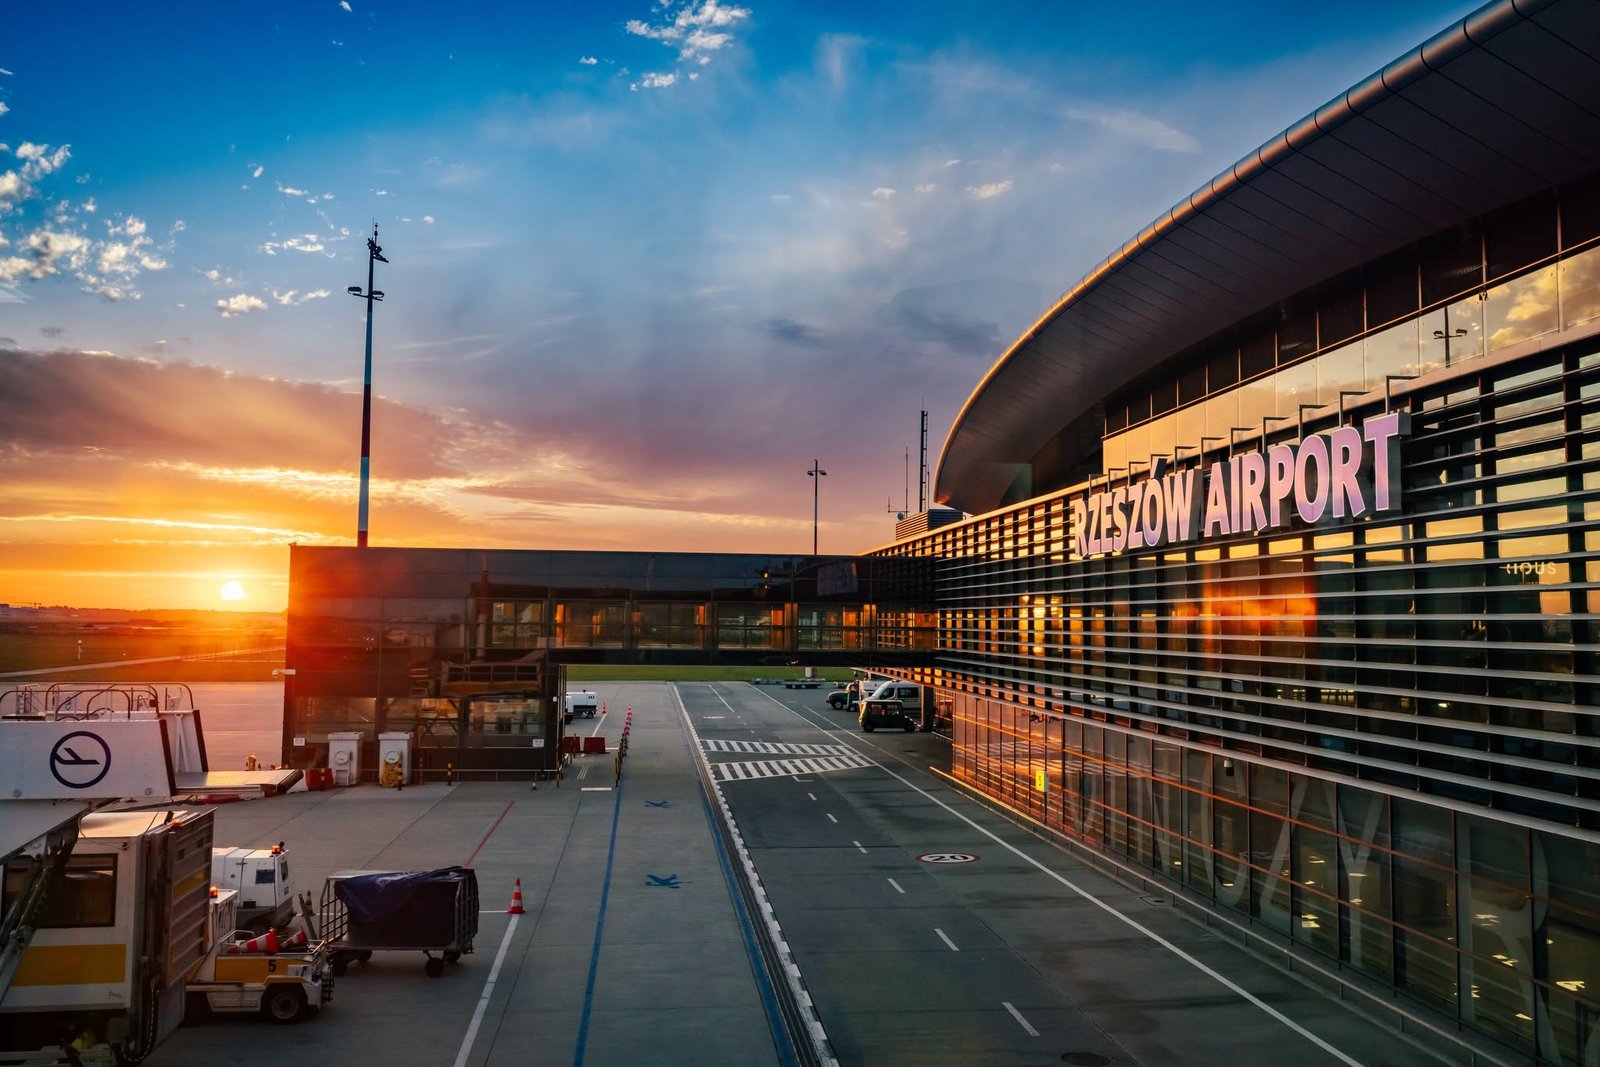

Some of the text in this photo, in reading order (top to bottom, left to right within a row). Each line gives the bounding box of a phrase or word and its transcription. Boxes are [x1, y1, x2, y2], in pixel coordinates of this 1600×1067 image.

[1074, 413, 1399, 557] RZESZÓW AIRPORT
[268, 960, 276, 972] 5
